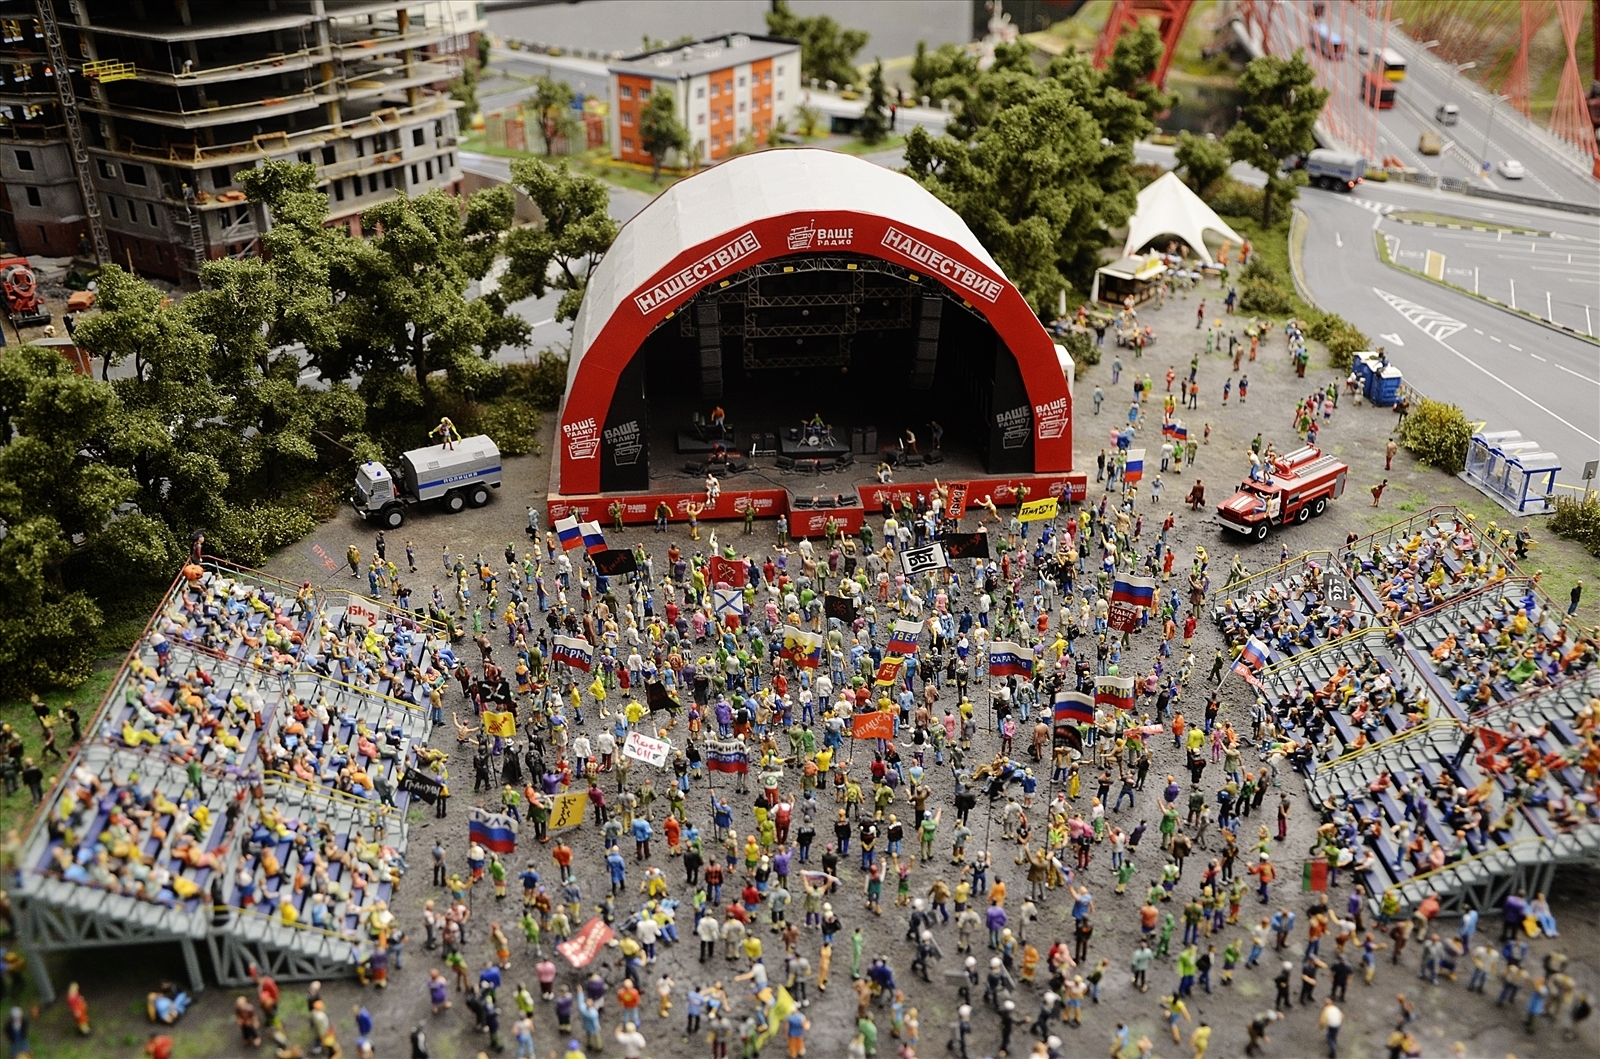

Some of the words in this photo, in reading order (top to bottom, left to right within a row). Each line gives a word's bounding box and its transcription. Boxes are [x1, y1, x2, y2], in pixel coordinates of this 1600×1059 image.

[818, 228, 853, 239] ВАШЕ
[638, 234, 757, 311] НАШЕСТВИЕ
[885, 229, 1001, 300] НАШЕСТВИЕ
[996, 405, 1030, 423] ВАШЕ
[1035, 397, 1067, 413] ВАШЕ
[563, 417, 596, 433] ВАШЕ
[604, 420, 640, 439] ВАШЕ
[443, 472, 478, 483] ПОЛИЦИЯ
[555, 645, 590, 664] ПЕРМЬ
[1097, 685, 1133, 699] КРЫМ
[475, 811, 512, 829] ТУЛА
